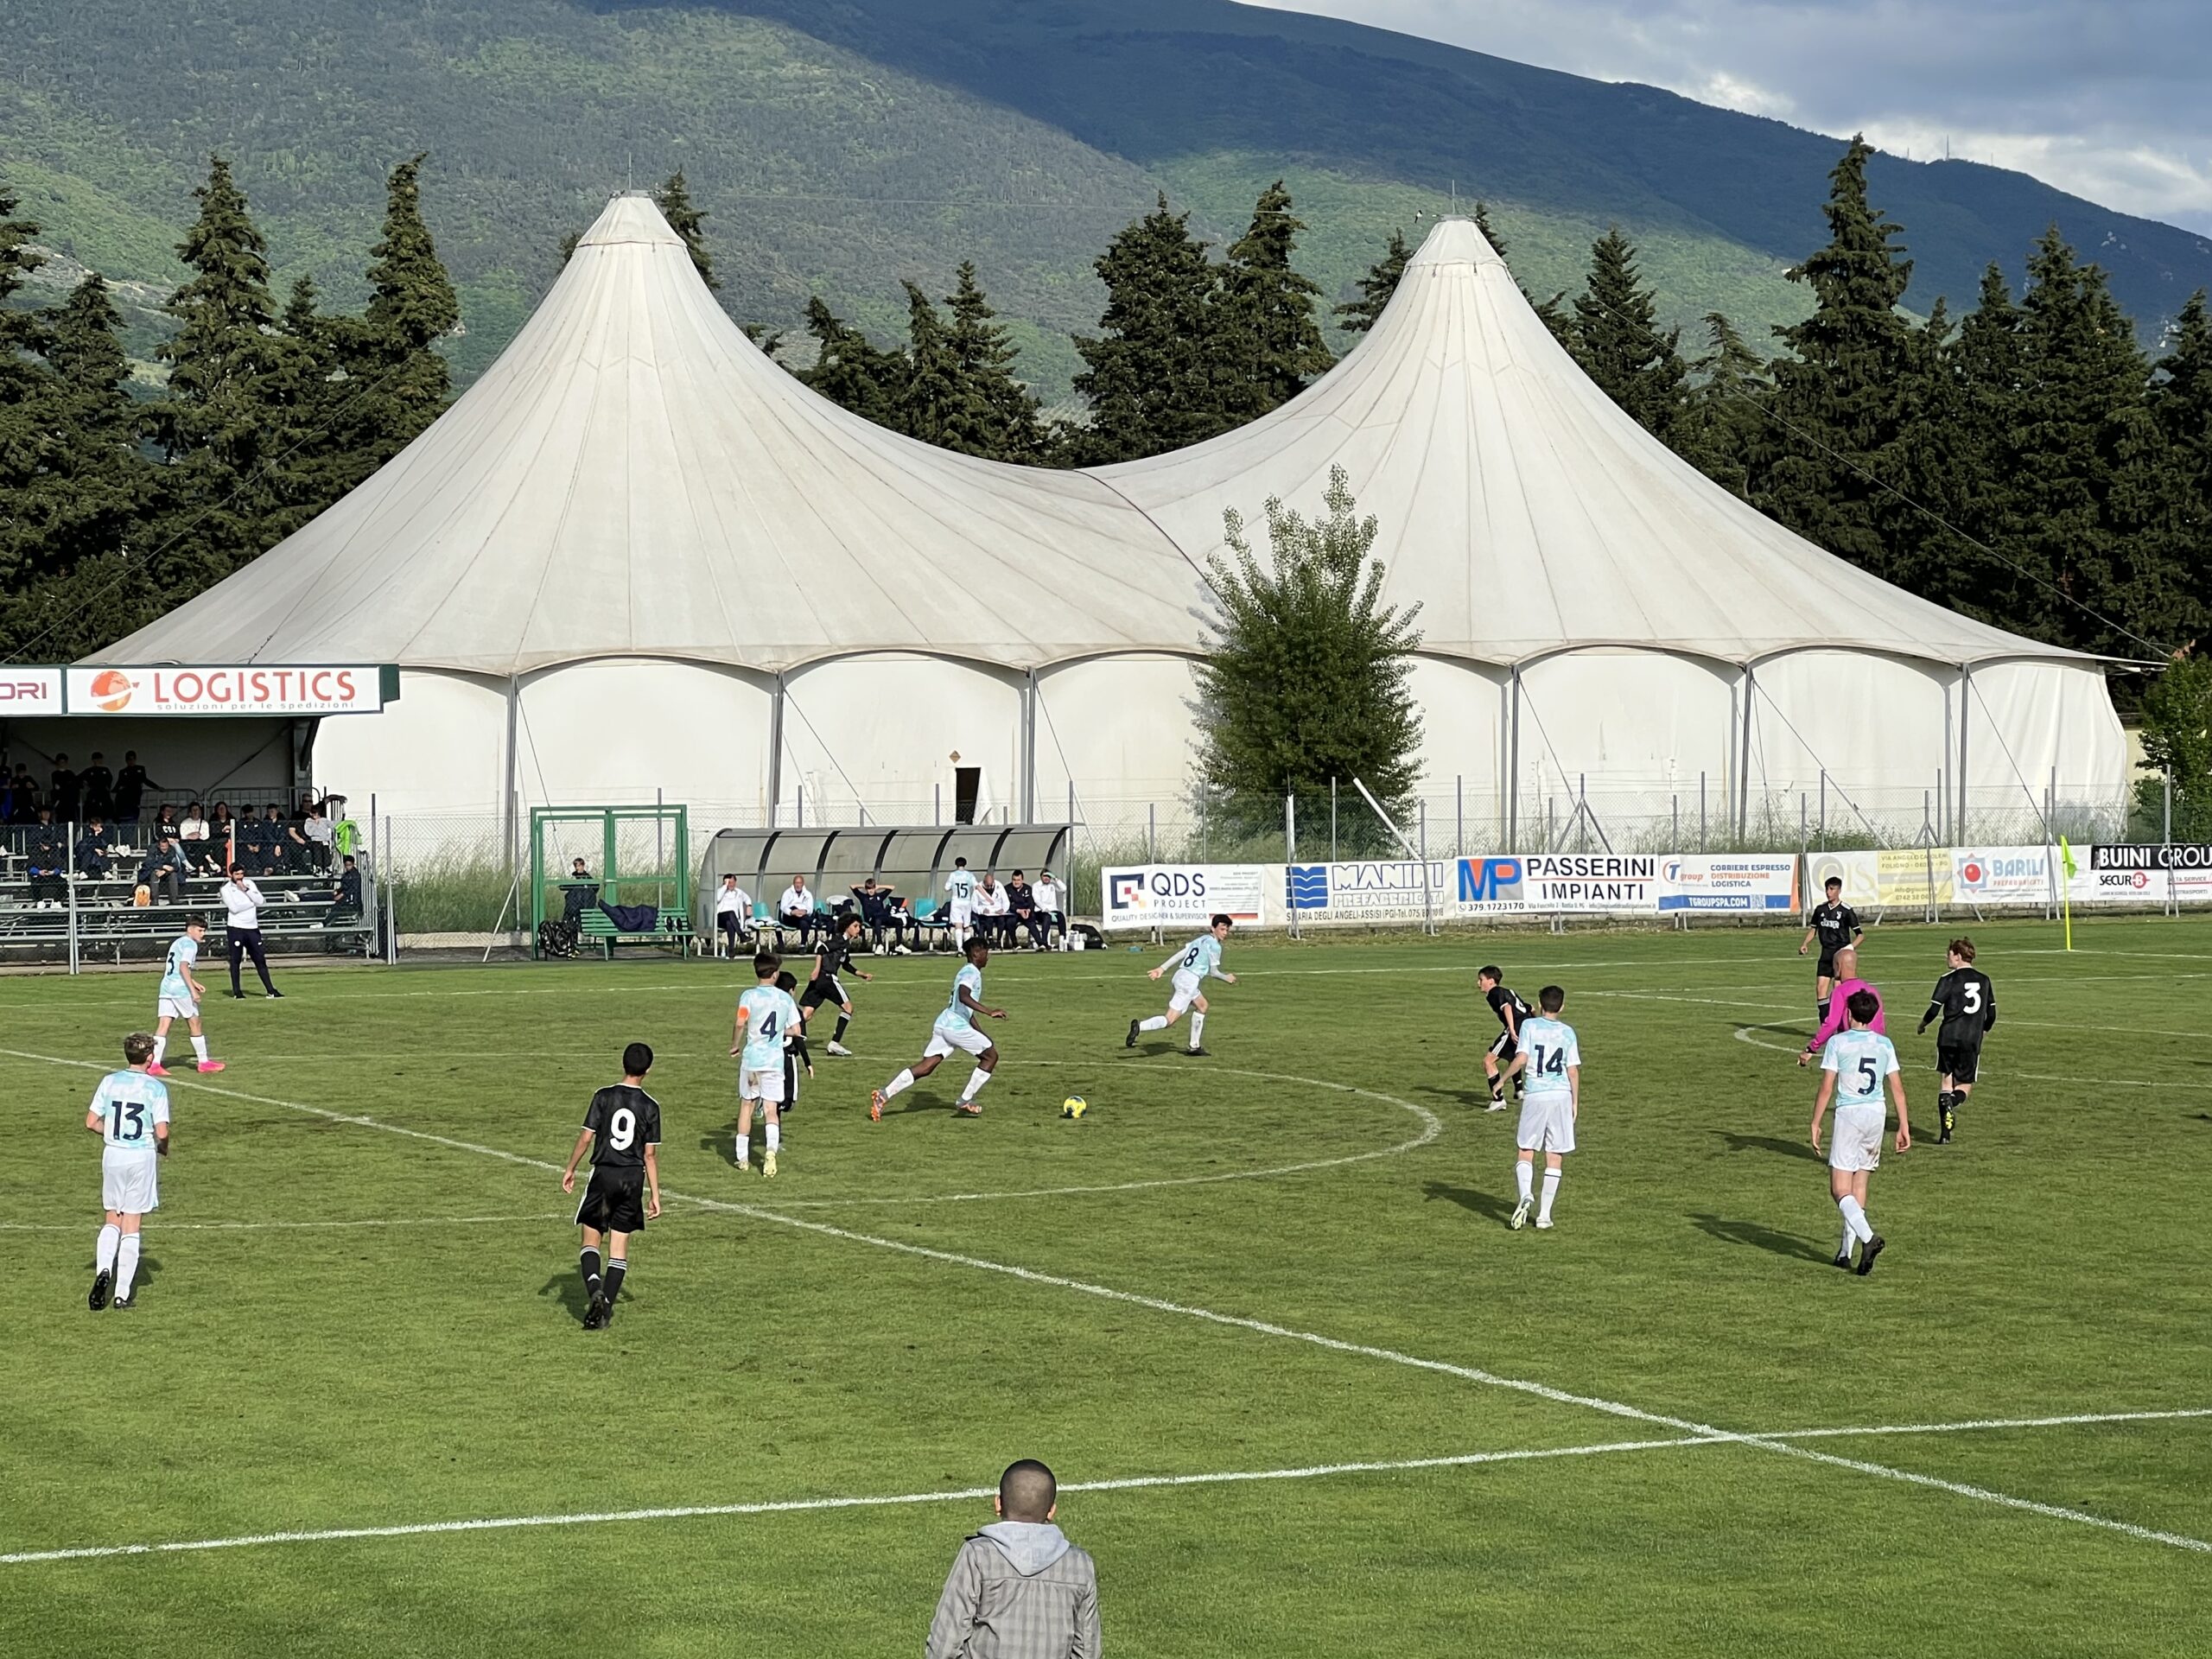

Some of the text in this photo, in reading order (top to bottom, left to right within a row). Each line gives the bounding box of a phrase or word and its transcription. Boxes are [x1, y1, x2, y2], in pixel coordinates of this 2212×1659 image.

[154, 671, 355, 702] LOGISTICS
[1527, 858, 1654, 876] PASSERINI
[1993, 858, 2044, 877] BARILI
[2099, 847, 2212, 868] BUINI GROU
[1151, 873, 1205, 897] QDS
[1332, 862, 1444, 891] MANINI
[1458, 858, 1522, 902] MP
[956, 882, 968, 899] 15
[1542, 883, 1643, 899] IMPIANTI
[1154, 899, 1206, 908] PROJECT
[1468, 903, 1524, 912] 379.1723170
[1688, 897, 1748, 907] TGROUPSPA.COM
[1314, 911, 1332, 920] DEGLI
[1184, 947, 1199, 967] 8
[1963, 982, 1981, 1014] 3
[760, 1011, 778, 1042] 4
[1535, 1045, 1563, 1077] 14
[1858, 1058, 1877, 1095] 5
[111, 1101, 144, 1141] 13
[609, 1108, 636, 1151] 9
